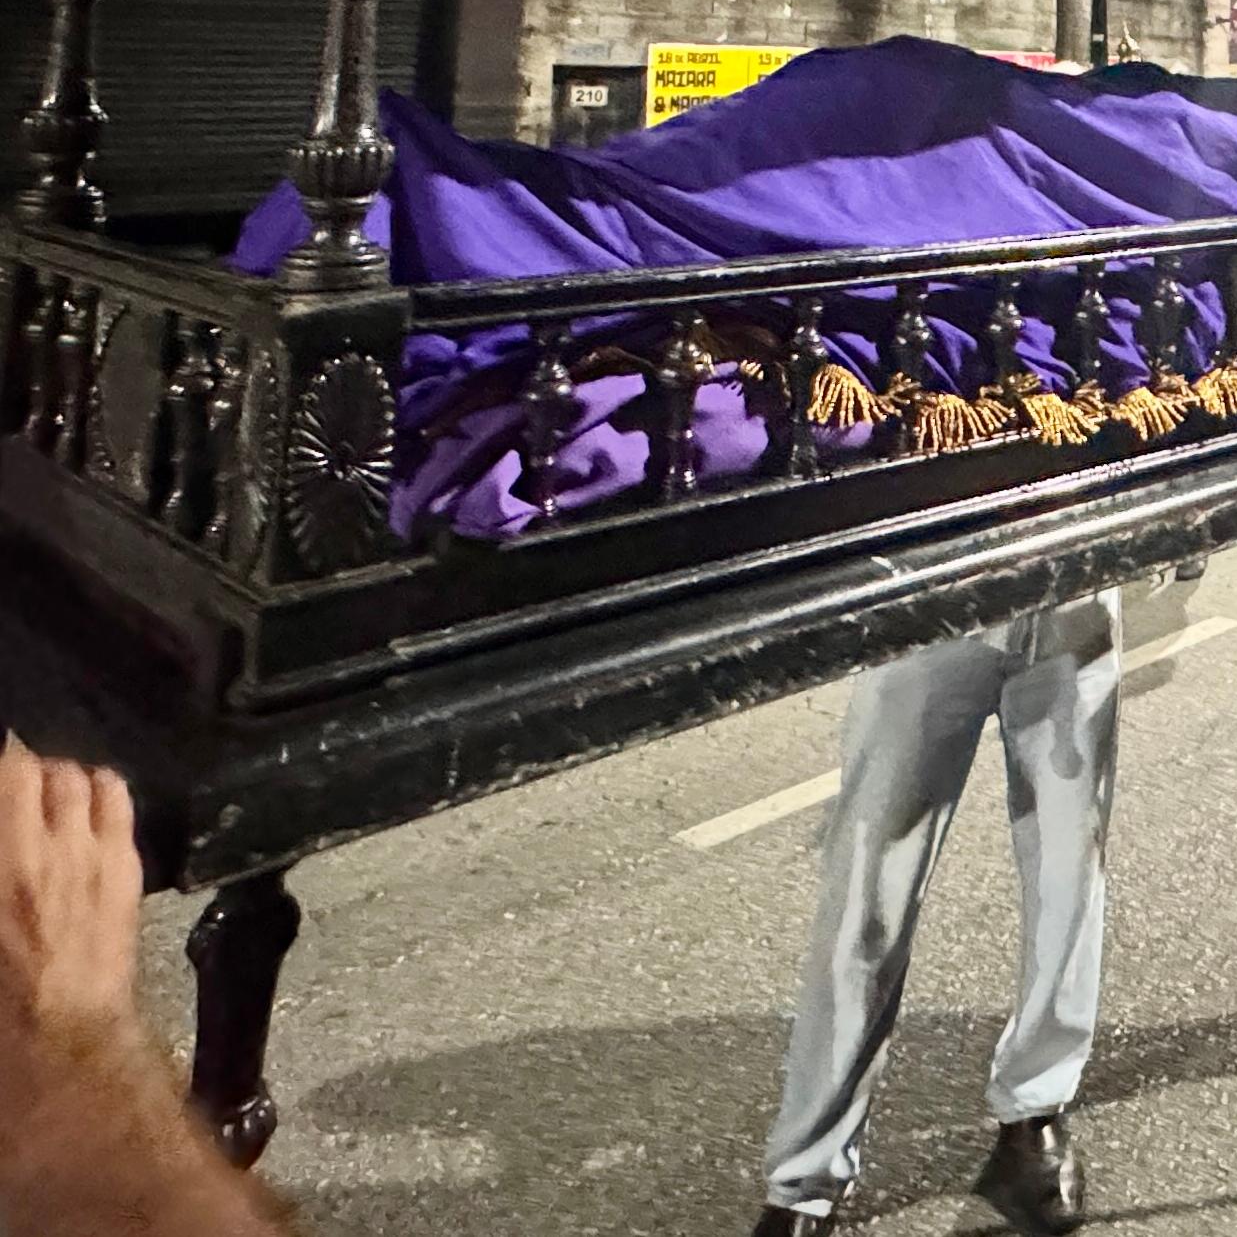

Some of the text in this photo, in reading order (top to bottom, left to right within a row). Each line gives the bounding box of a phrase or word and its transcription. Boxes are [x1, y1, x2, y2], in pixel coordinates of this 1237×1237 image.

[658, 52, 673, 64] 18
[687, 52, 722, 64] ABRIL
[655, 70, 716, 88] MAIARA
[576, 89, 603, 102] 210
[654, 96, 666, 113] &
